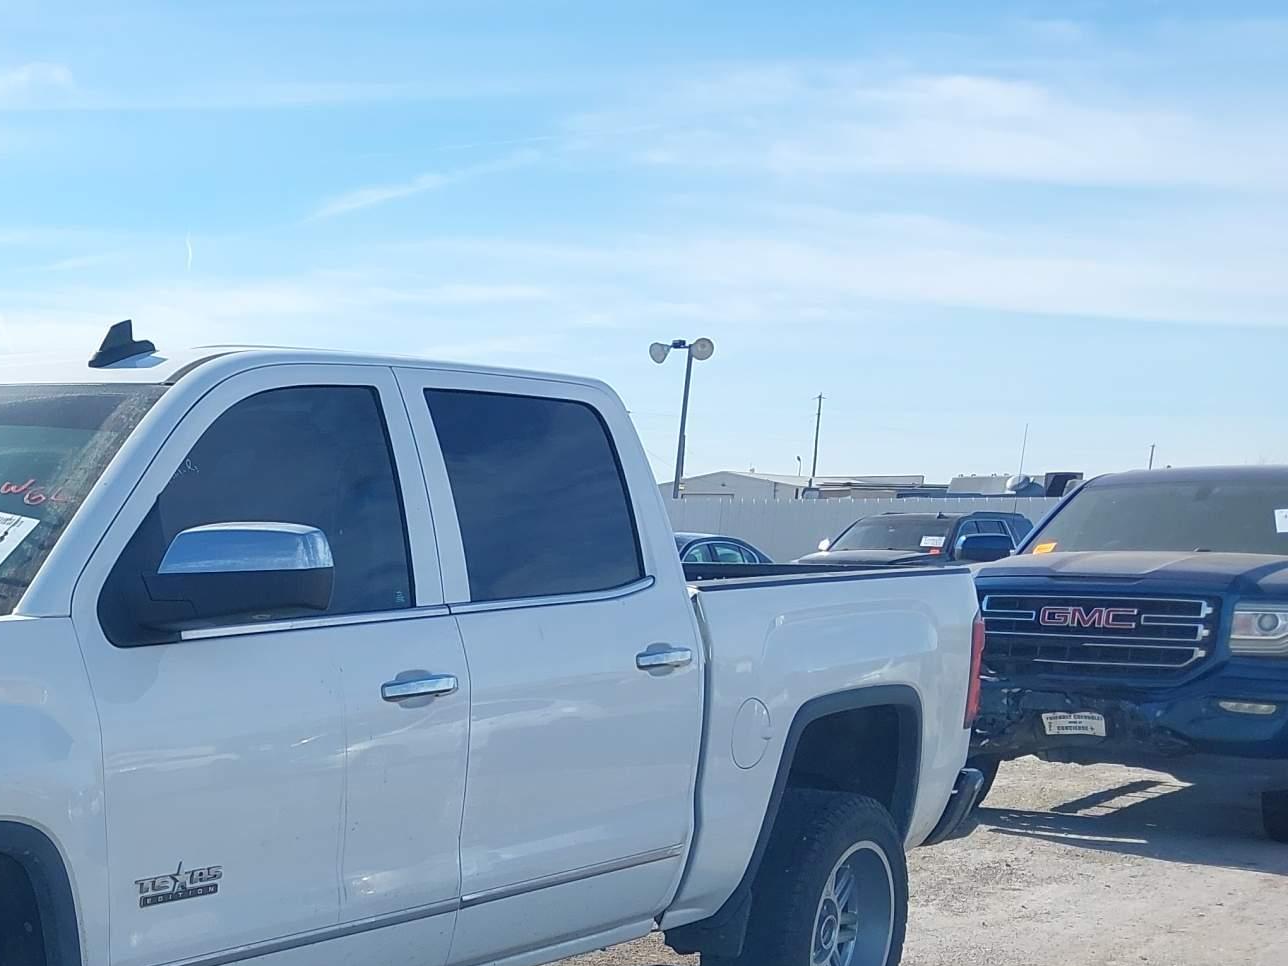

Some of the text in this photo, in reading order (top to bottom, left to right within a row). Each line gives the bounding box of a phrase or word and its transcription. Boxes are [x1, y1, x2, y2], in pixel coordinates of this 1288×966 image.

[1039, 606, 1138, 629] GMC
[135, 862, 223, 895] TEXAS
[145, 885, 216, 905] EDITION
